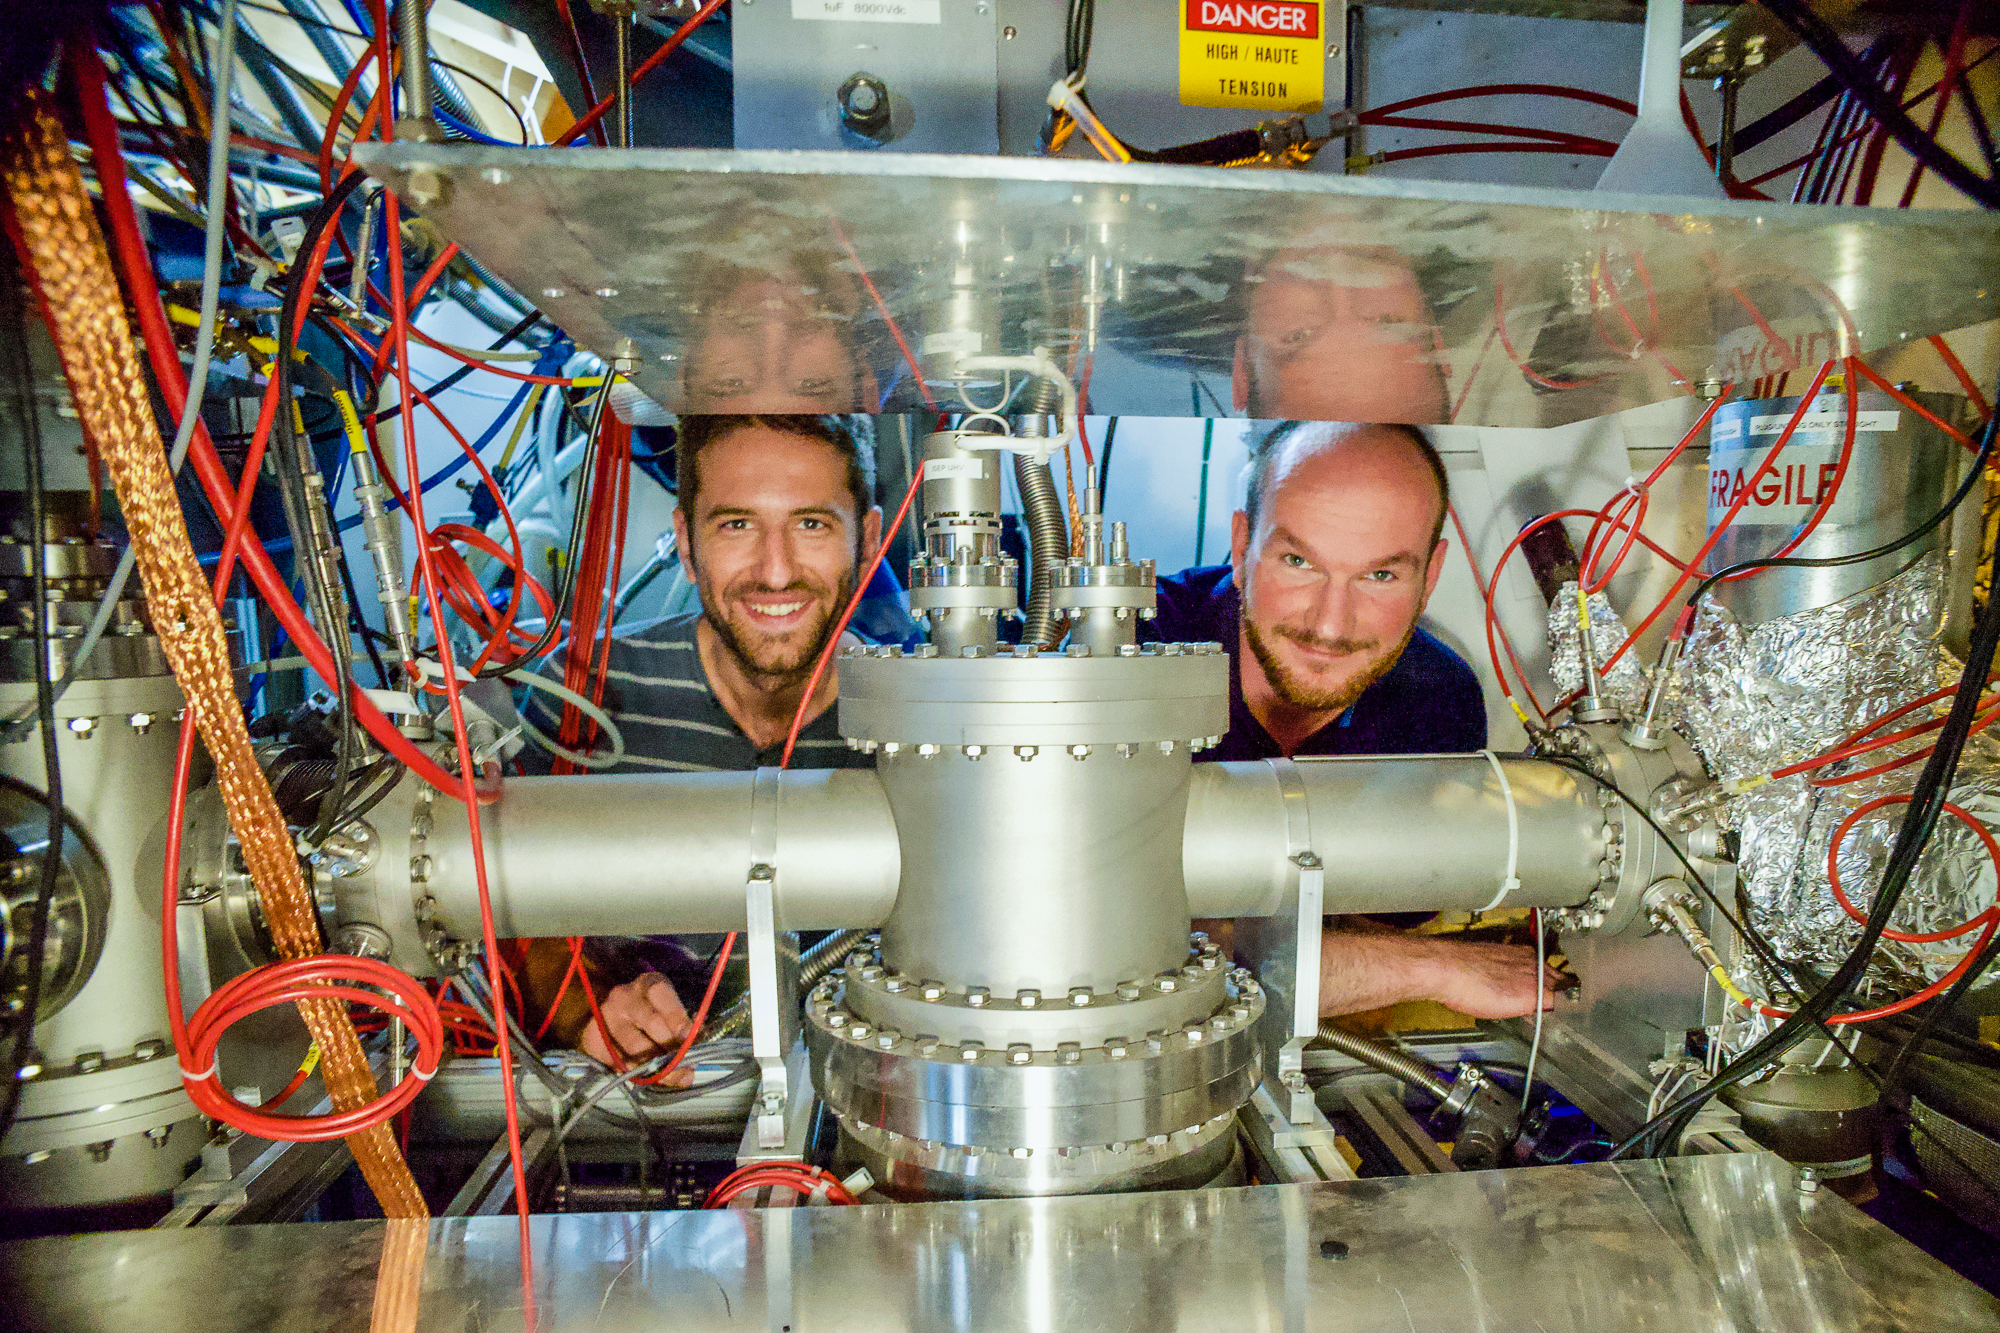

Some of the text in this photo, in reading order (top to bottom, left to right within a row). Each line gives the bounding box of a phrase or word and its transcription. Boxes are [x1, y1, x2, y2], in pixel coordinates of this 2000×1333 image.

[854, 3, 907, 15] 8000Vdc
[1201, 1, 1306, 31] DANGER
[1206, 43, 1299, 65] HIGH / HAUTE
[1219, 79, 1287, 98] TENSION
